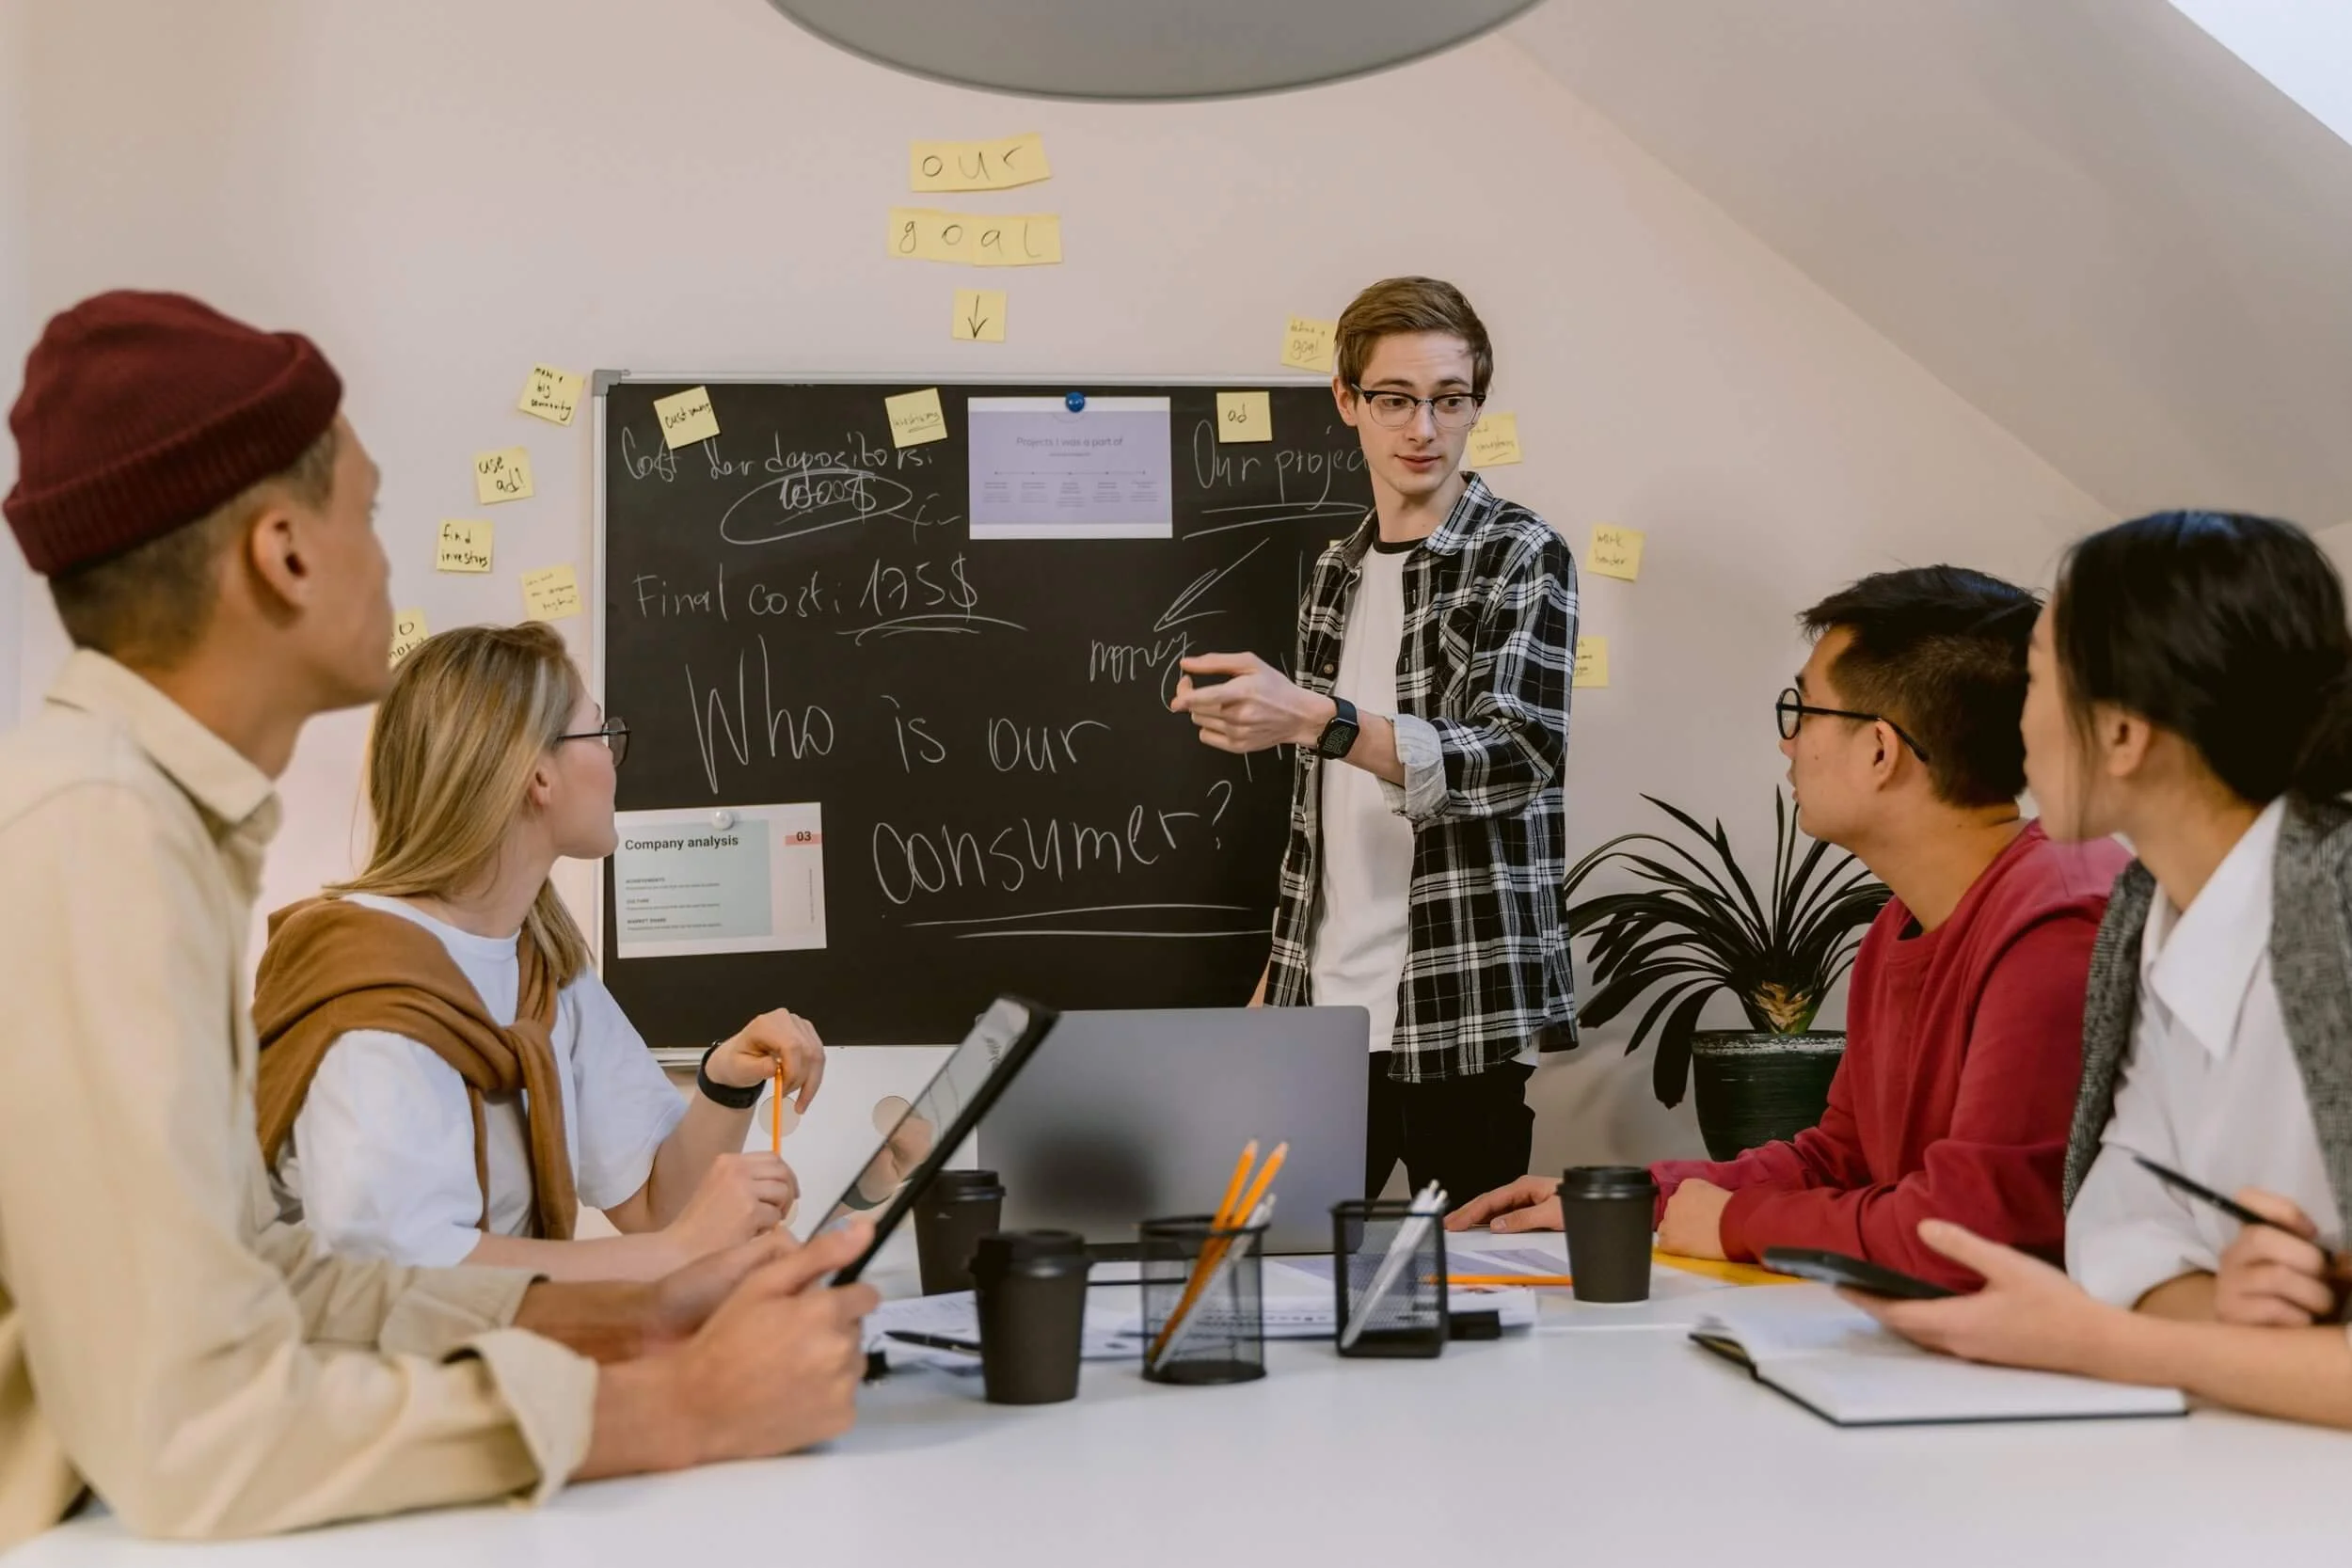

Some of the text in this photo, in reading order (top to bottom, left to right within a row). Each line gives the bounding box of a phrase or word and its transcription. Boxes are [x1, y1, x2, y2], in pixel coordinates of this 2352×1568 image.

[922, 146, 1024, 182] our
[898, 219, 1042, 259] goal
[1015, 436, 1054, 450] Projects
[1061, 437, 1081, 447] was
[1083, 437, 1090, 447] a
[1091, 436, 1112, 449] part
[1113, 435, 1123, 447] of
[478, 455, 504, 475] use
[1194, 420, 1368, 511] Our projec
[442, 522, 471, 544] find
[633, 563, 729, 622] Final
[685, 633, 1111, 796] Who is our
[625, 834, 739, 852] Company analysis
[796, 831, 813, 843] 03
